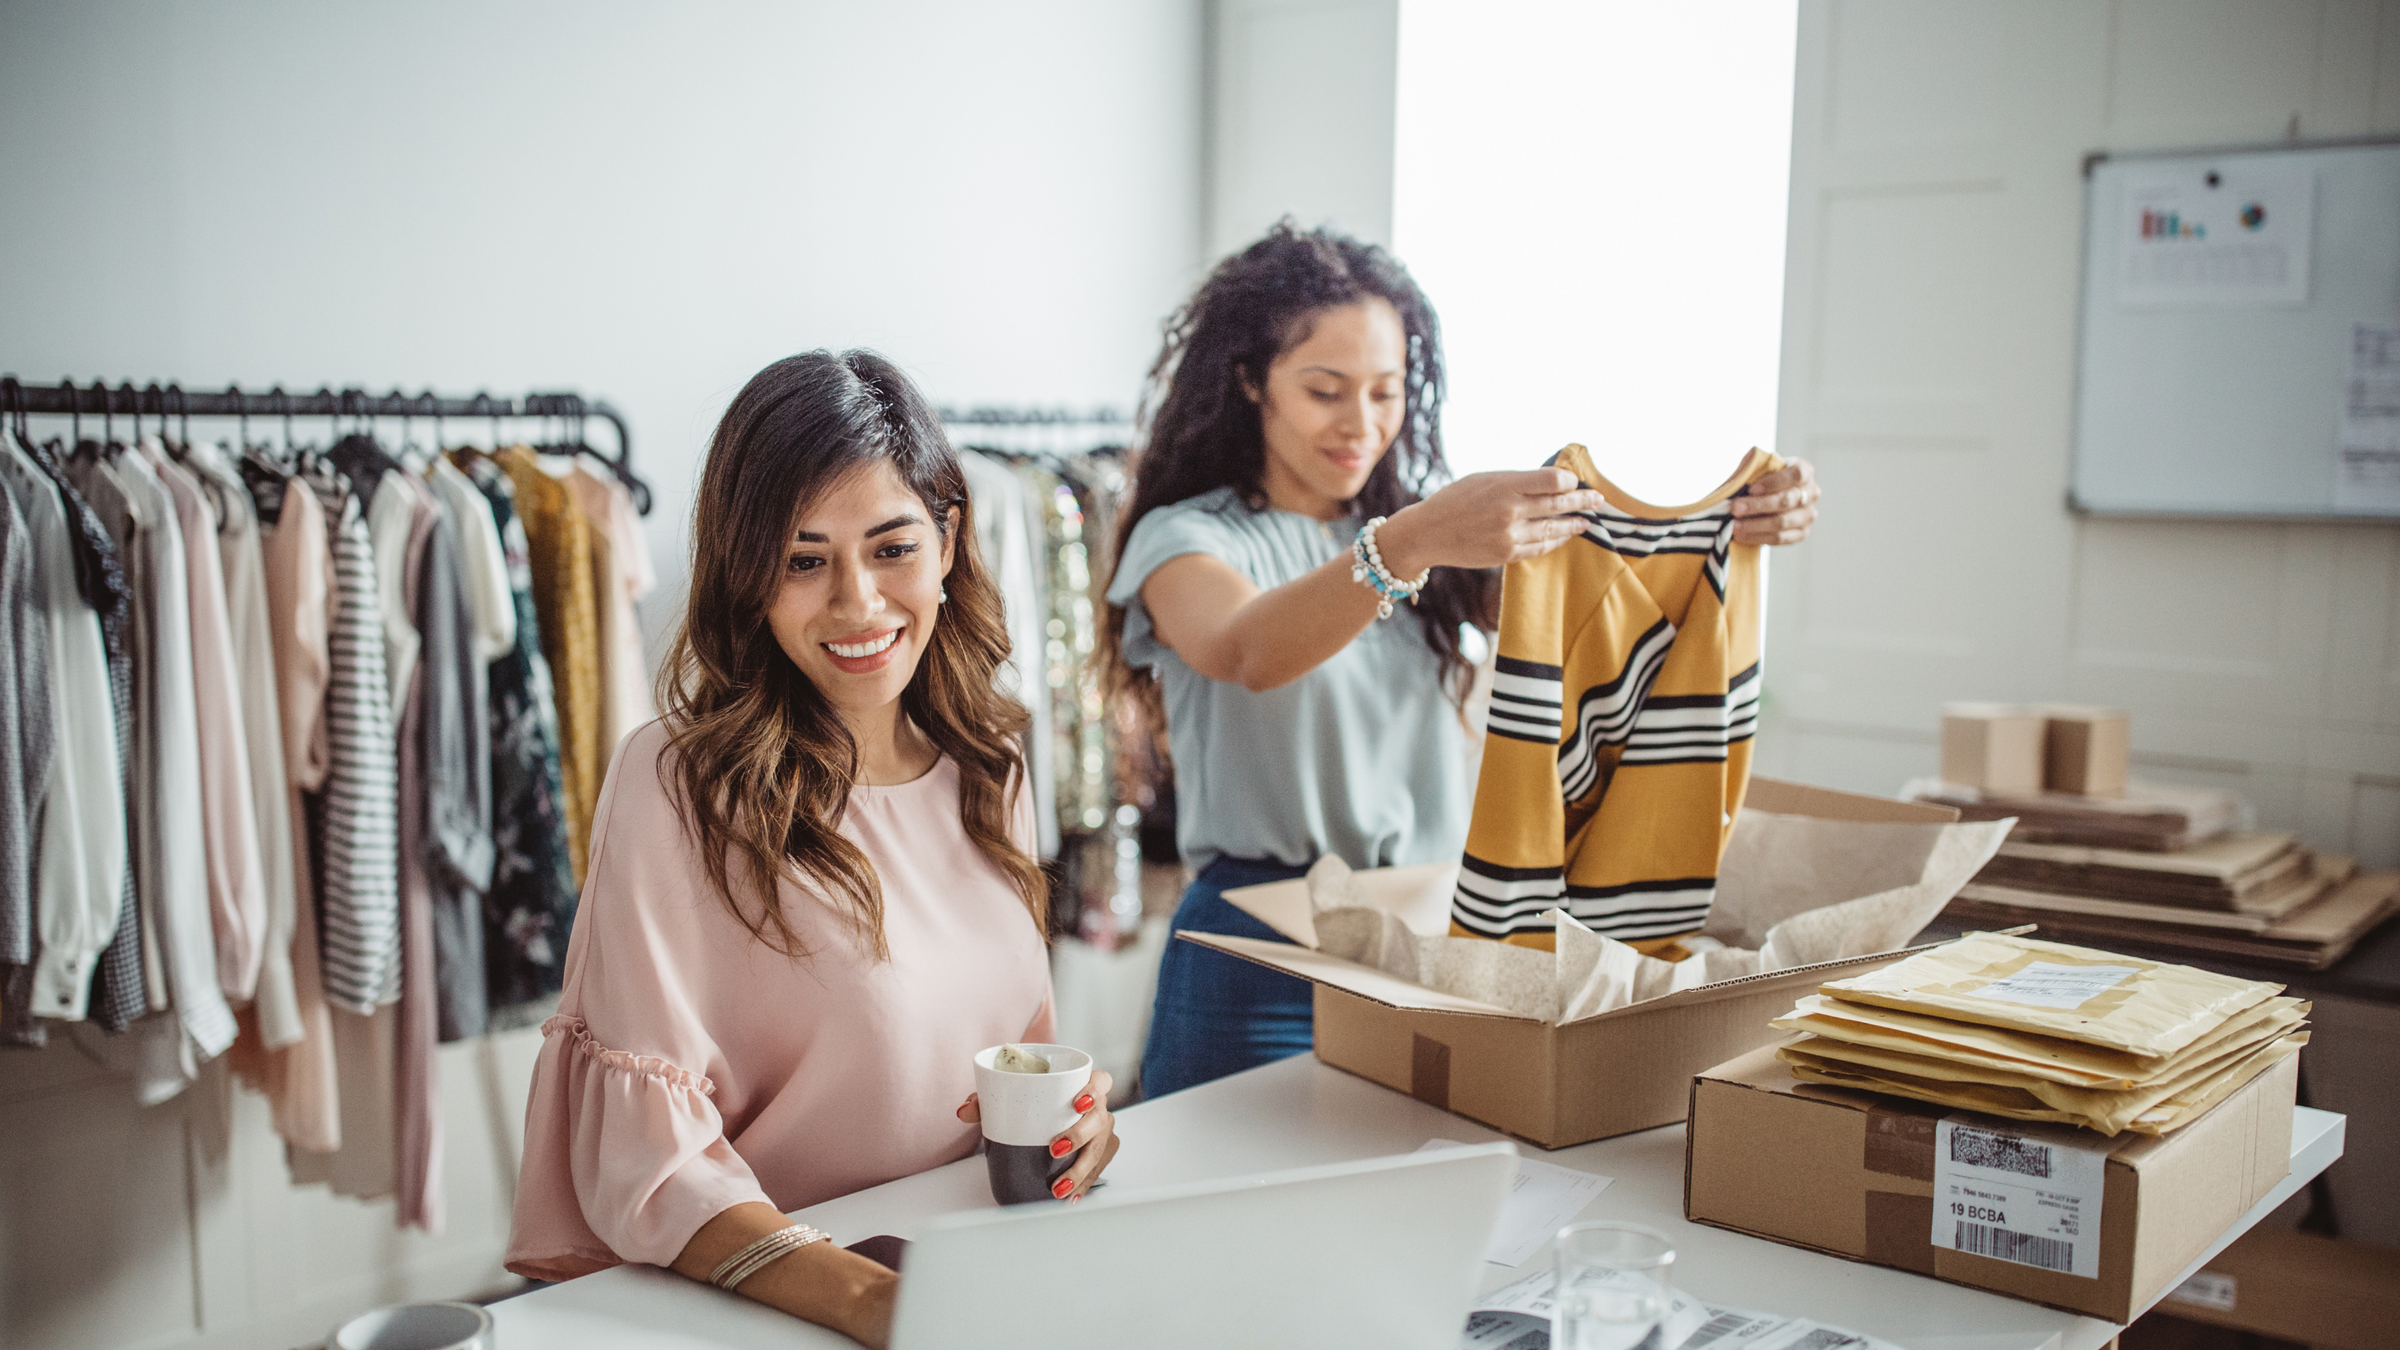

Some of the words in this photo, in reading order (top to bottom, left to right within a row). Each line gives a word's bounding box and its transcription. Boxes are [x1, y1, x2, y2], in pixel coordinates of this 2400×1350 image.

[2038, 1199, 2061, 1209] EXPRESS
[1950, 1202, 1965, 1216] 19
[1968, 1205, 2006, 1224] BCBA
